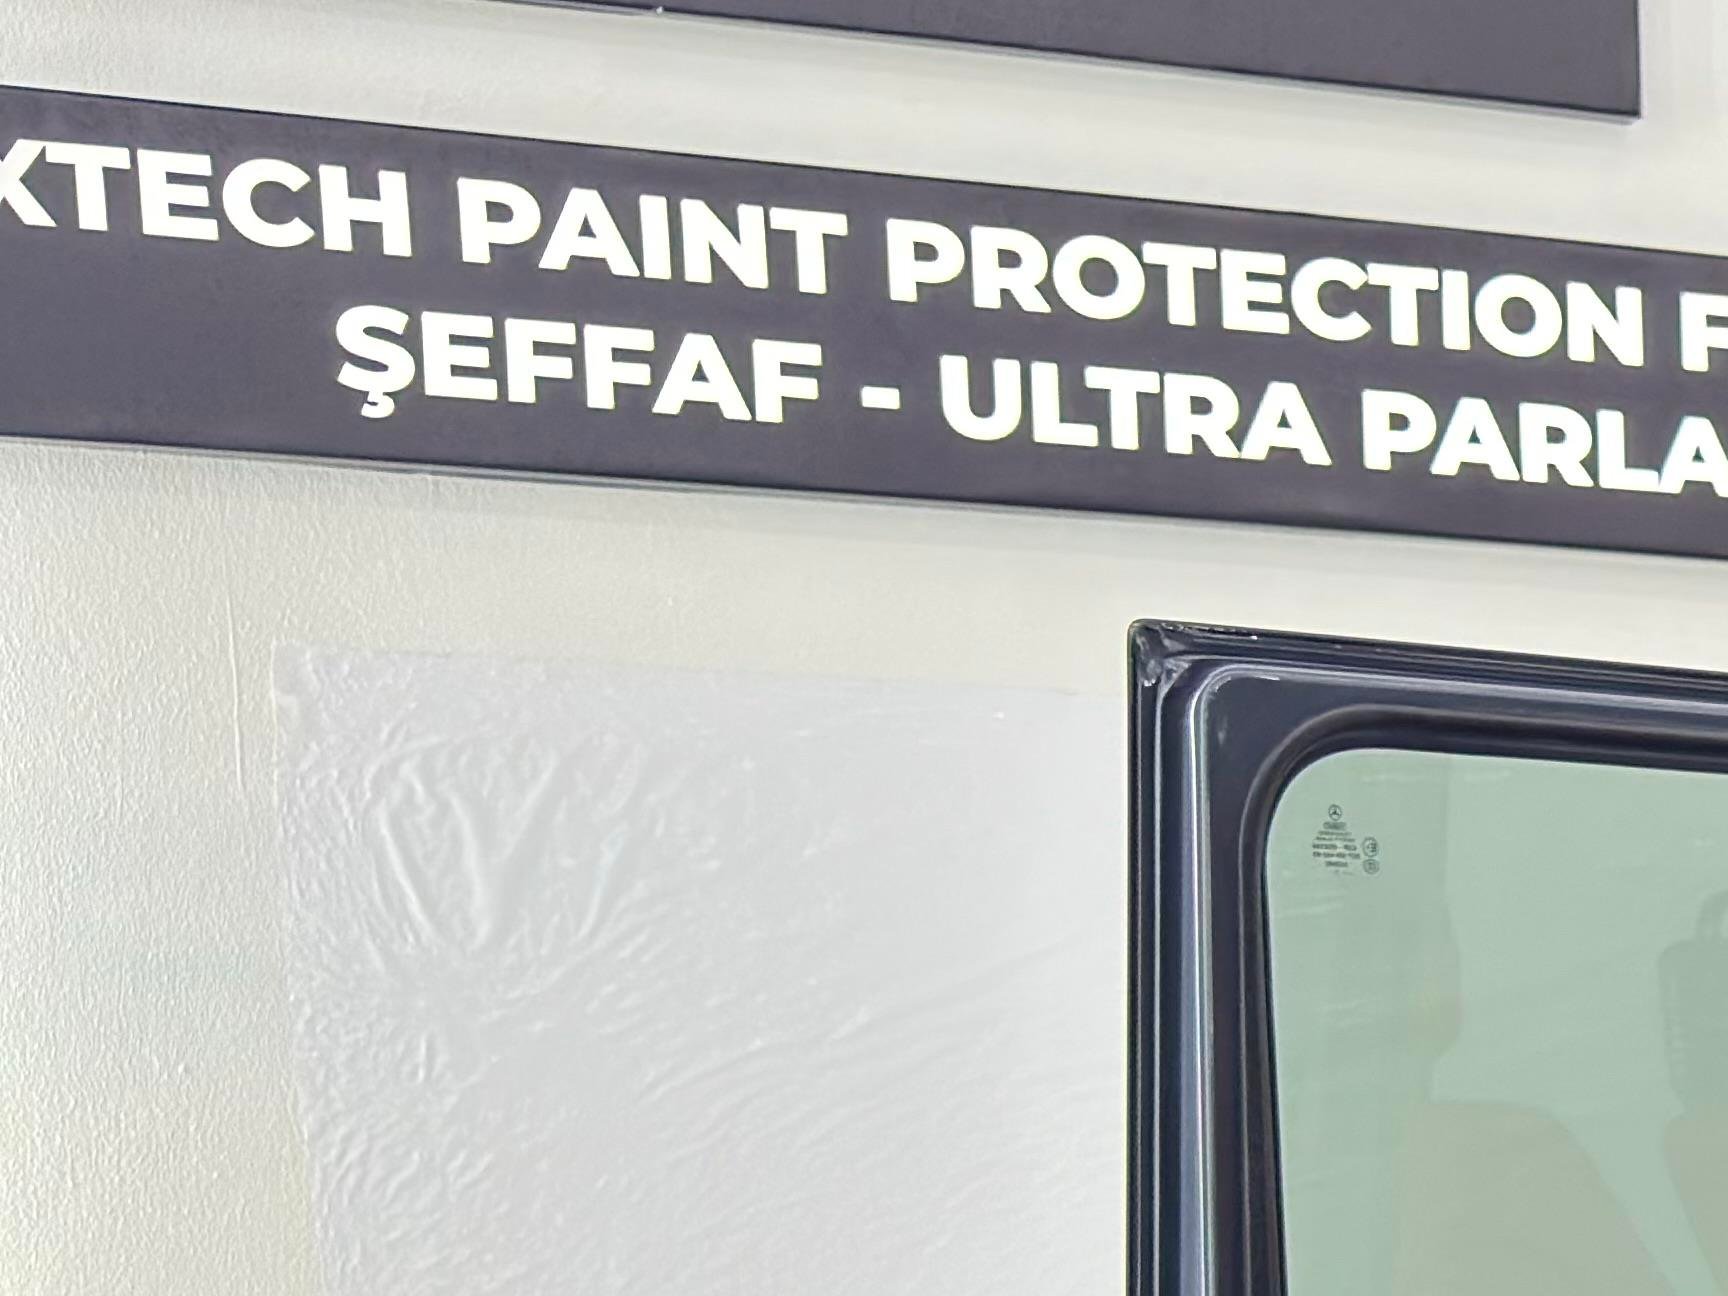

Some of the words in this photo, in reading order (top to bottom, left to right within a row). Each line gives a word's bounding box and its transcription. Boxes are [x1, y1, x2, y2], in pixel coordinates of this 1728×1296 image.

[0, 138, 412, 257] XTECH
[456, 177, 848, 294] PAINT
[886, 218, 1644, 367] PROTECTION
[335, 304, 822, 423] ŞEFFAF
[861, 386, 900, 410] -
[939, 354, 1332, 466] ULTRA
